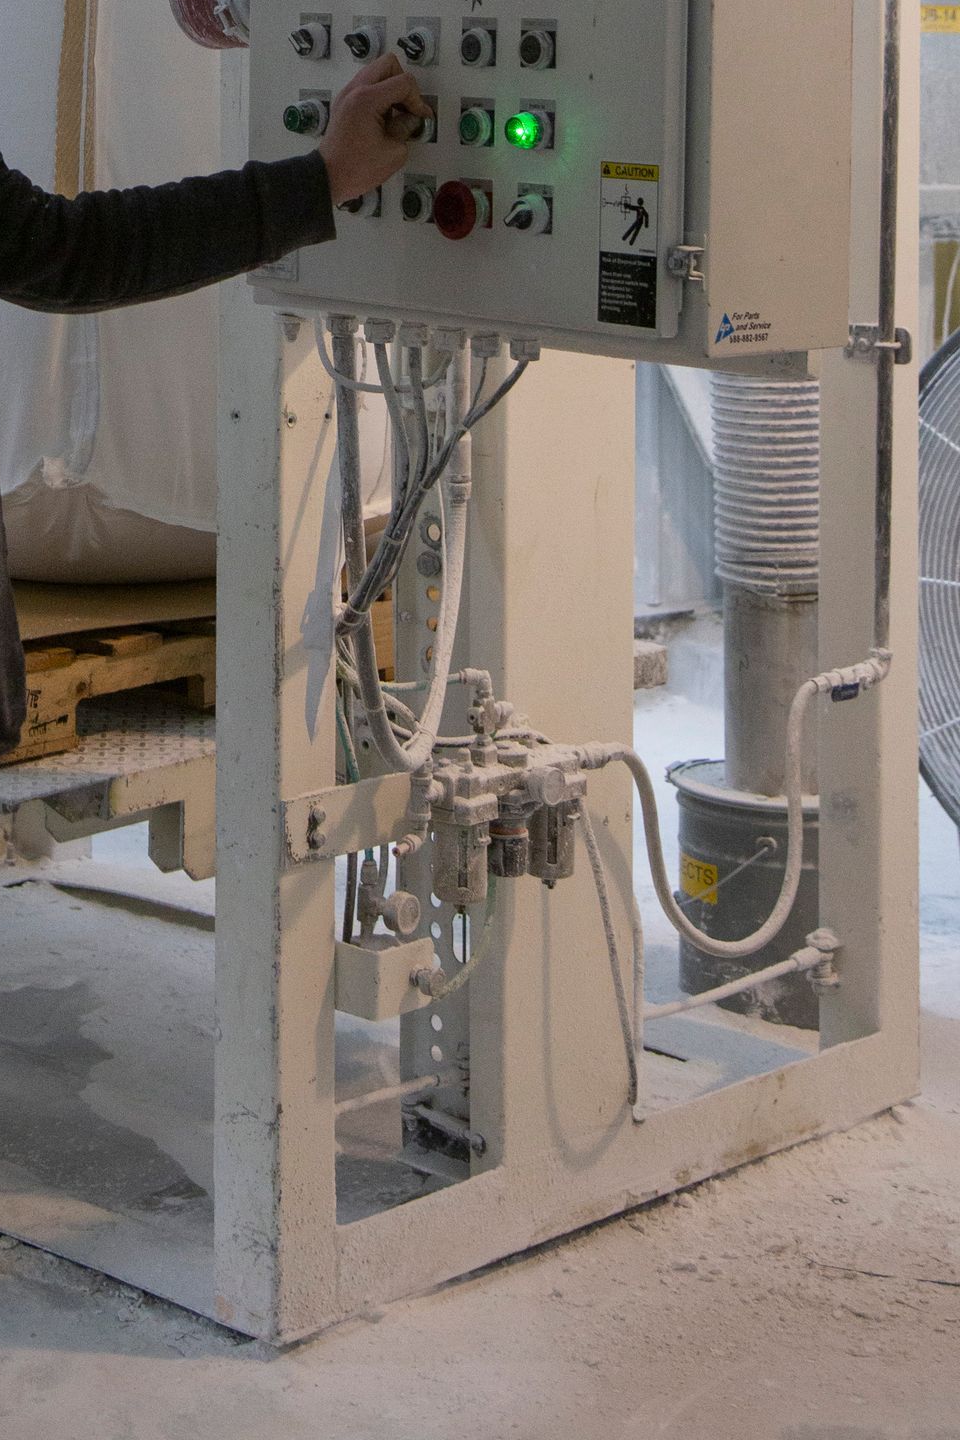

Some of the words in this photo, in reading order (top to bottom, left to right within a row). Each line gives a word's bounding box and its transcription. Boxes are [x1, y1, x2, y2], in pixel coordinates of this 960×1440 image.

[615, 165, 655, 178] CAUTION
[732, 312, 744, 321] For
[744, 311, 760, 320] Parts
[735, 322, 748, 331] and
[748, 321, 771, 330] Service
